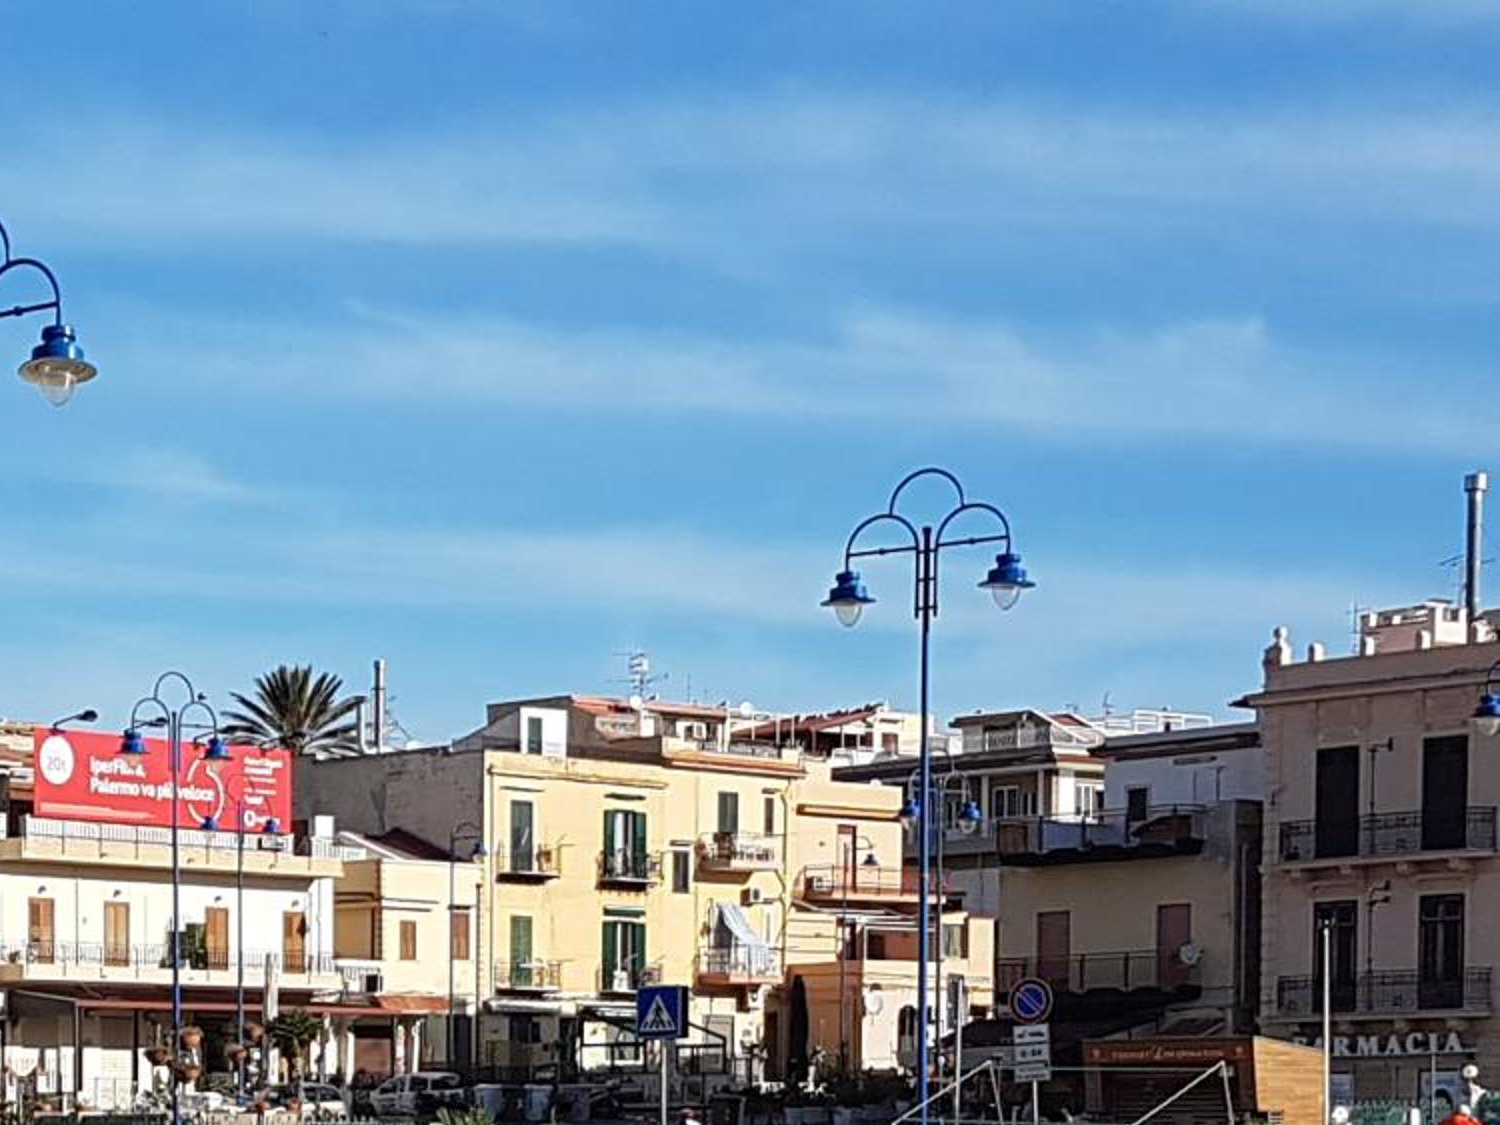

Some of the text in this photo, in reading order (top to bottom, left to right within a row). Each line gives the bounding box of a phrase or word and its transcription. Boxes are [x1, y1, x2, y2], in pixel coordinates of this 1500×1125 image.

[90, 776, 139, 797] Palermo
[141, 783, 155, 798] va
[177, 784, 214, 801] veloce
